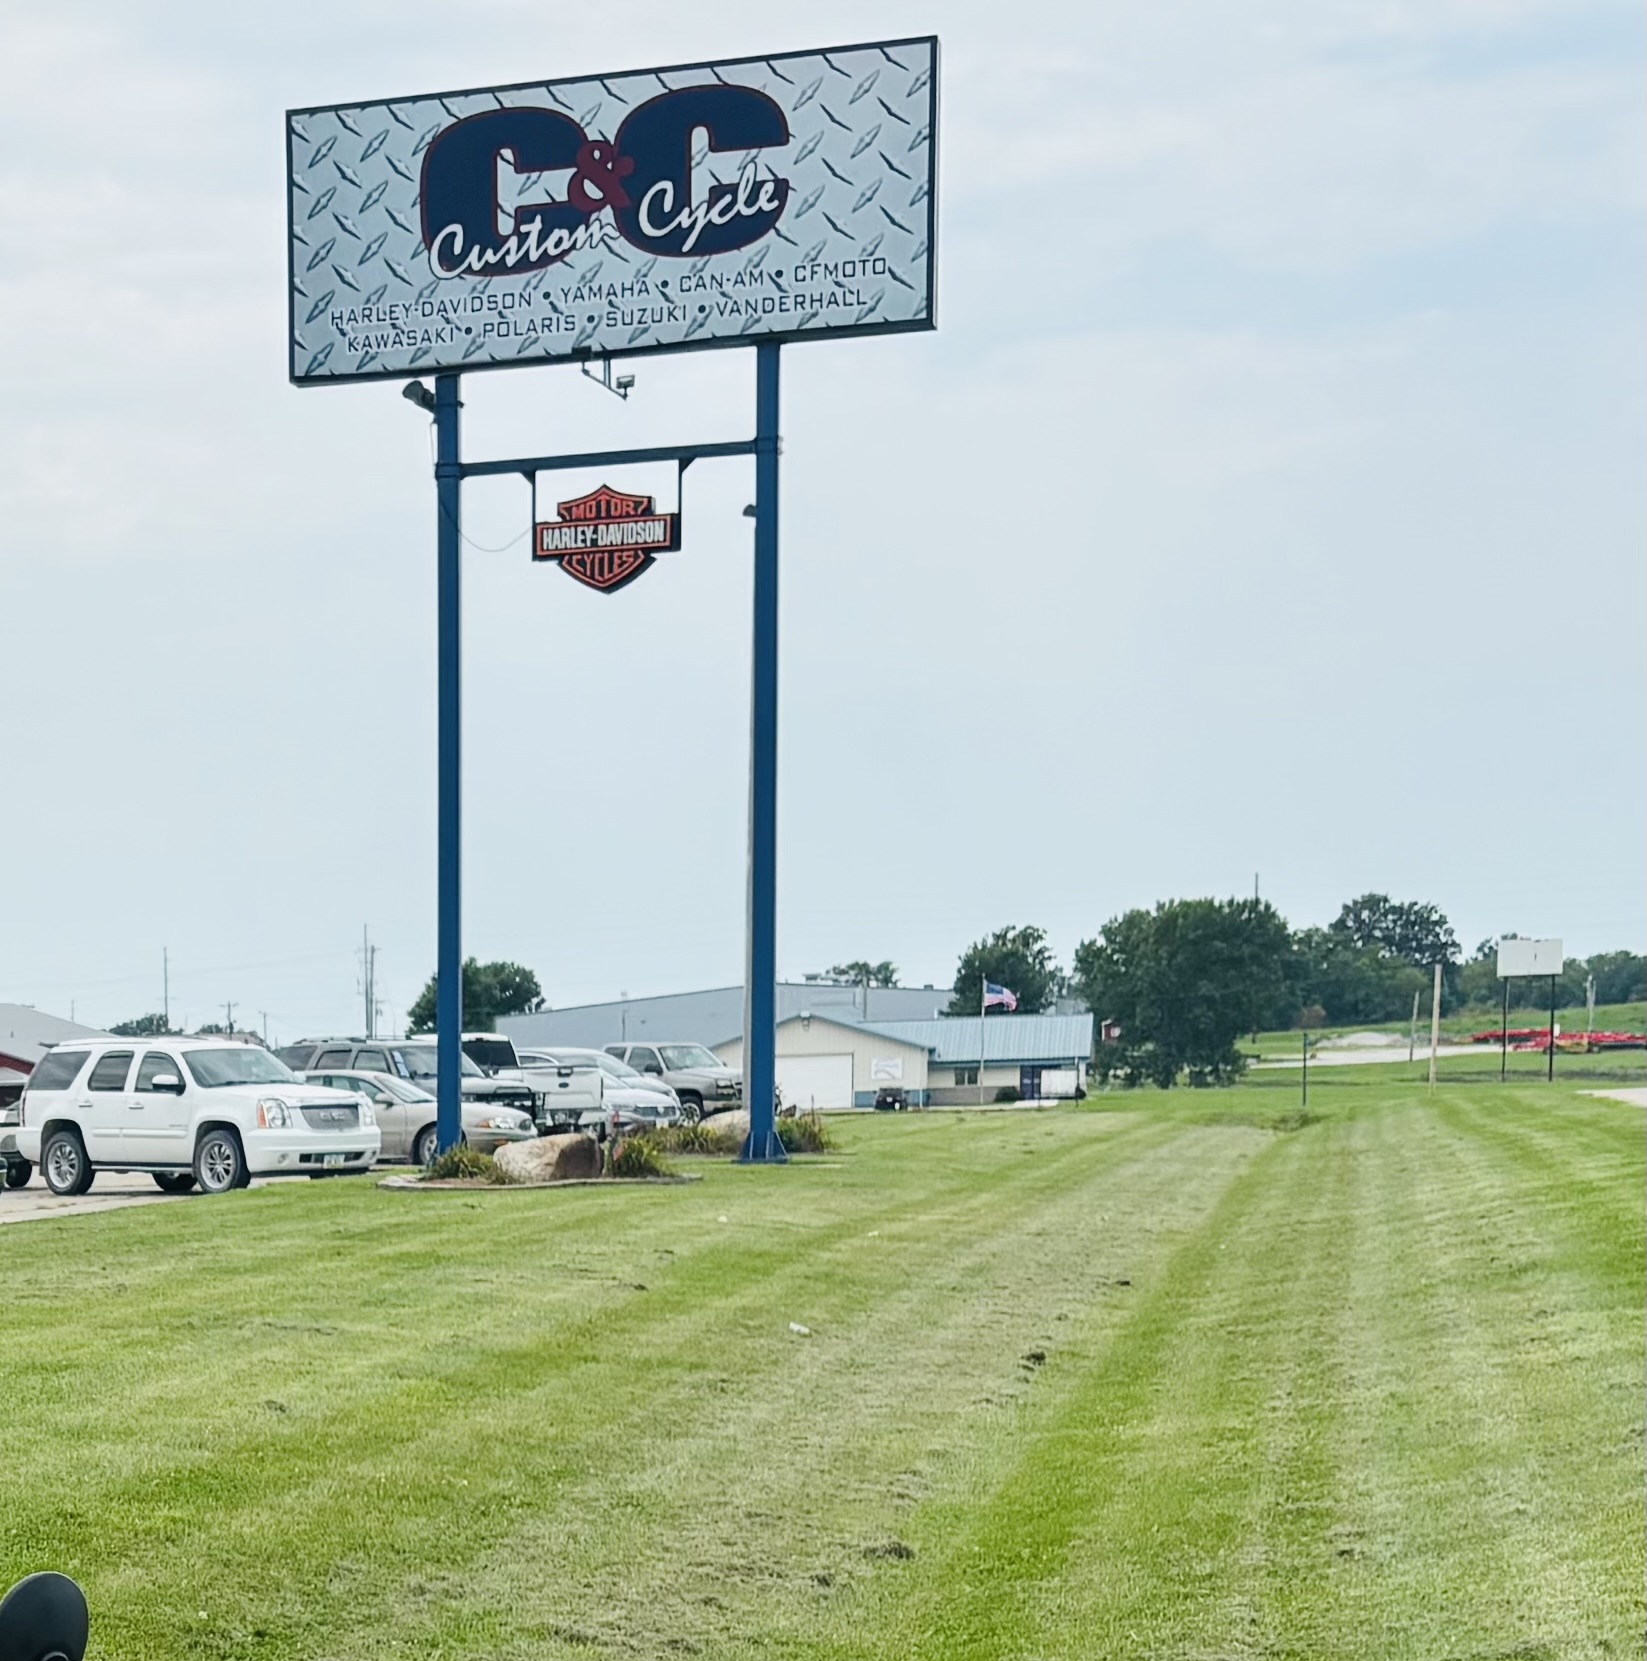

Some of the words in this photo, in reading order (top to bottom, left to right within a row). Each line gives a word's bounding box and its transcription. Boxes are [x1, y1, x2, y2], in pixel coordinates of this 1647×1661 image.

[428, 205, 620, 280] Custom
[638, 161, 780, 253] Cycle
[330, 290, 534, 328] HARLEY-DAVIDSON
[560, 279, 651, 304] YAMAHA
[678, 269, 764, 293] CAN-AM
[794, 257, 887, 283] CFMOTO
[347, 326, 455, 353] KAWASAKI
[482, 314, 576, 339] POLARIS
[605, 304, 687, 328] SUZUKI
[715, 288, 868, 318] VANDERHALL
[571, 494, 636, 519] MOTOR
[542, 519, 666, 551] HARLEY-DAVIDSON
[571, 550, 636, 582] CYCLES
